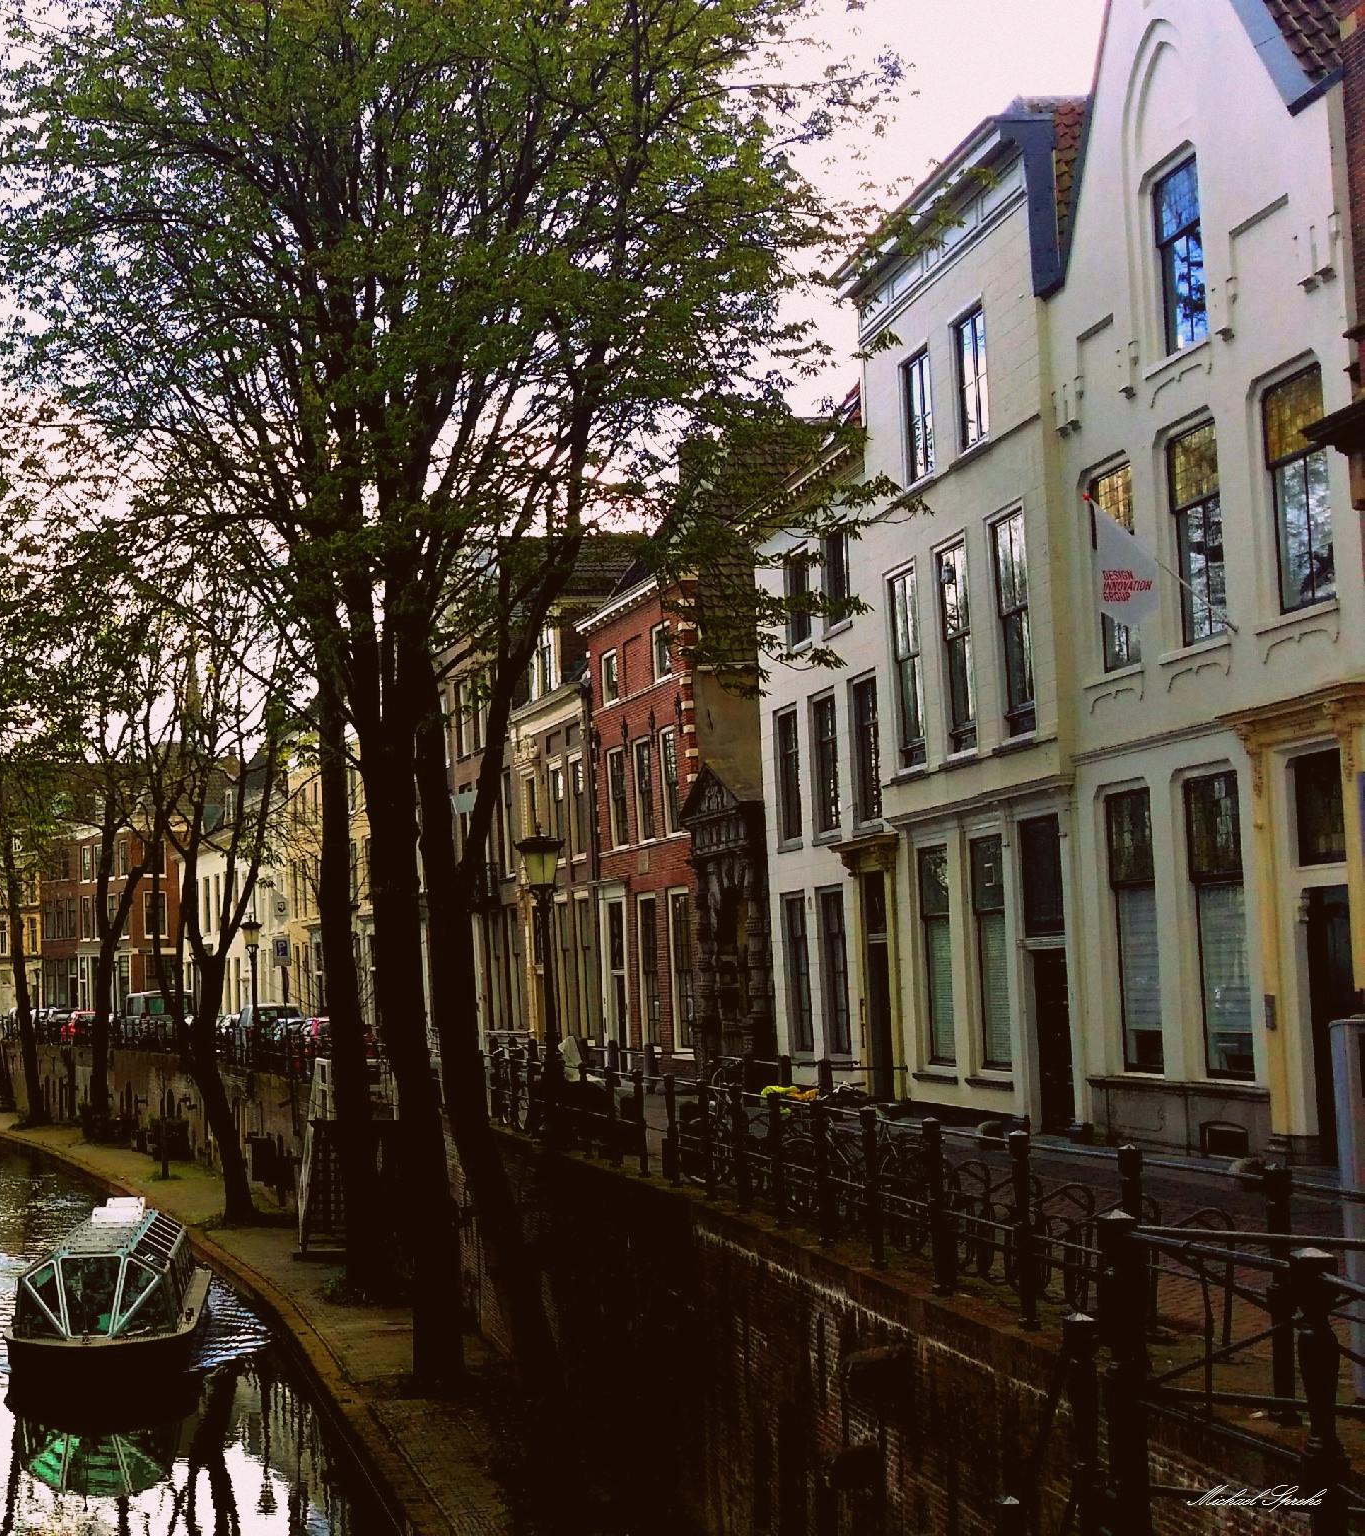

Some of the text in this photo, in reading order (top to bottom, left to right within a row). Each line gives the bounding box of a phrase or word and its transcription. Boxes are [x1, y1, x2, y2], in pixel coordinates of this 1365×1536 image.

[1102, 570, 1134, 581] DESIGN
[1103, 580, 1153, 591] INNOVATION
[1102, 591, 1131, 602] GROUP
